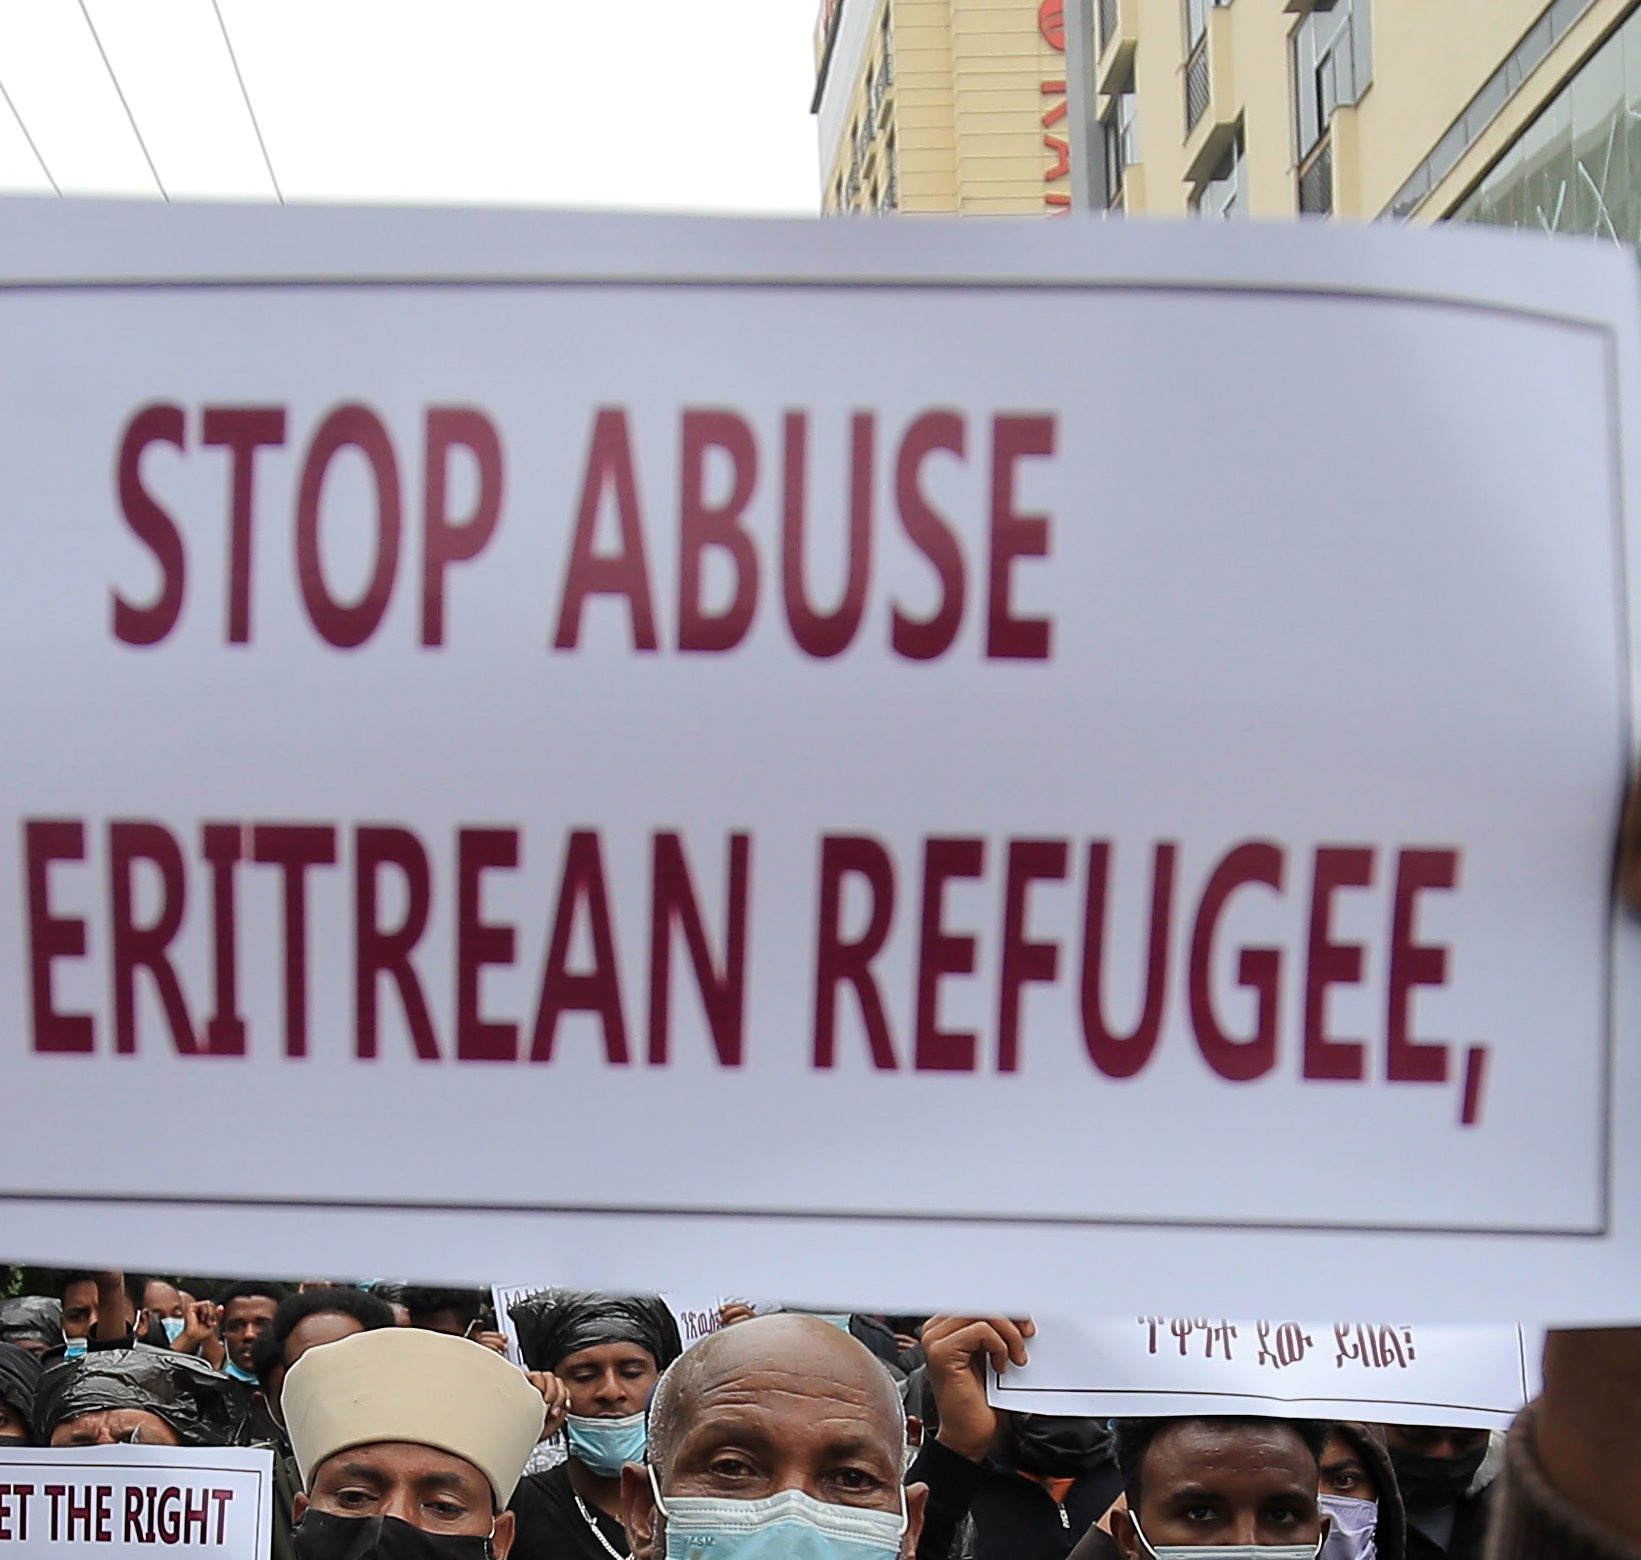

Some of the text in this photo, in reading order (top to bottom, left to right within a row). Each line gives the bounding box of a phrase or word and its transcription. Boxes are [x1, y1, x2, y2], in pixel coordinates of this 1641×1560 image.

[109, 401, 1058, 662] STOP ABUSE
[26, 816, 750, 1068] ERITREAN
[811, 834, 1490, 1128] REFUGEE,
[45, 1485, 113, 1543] THE
[124, 1486, 234, 1546] RIGHT
